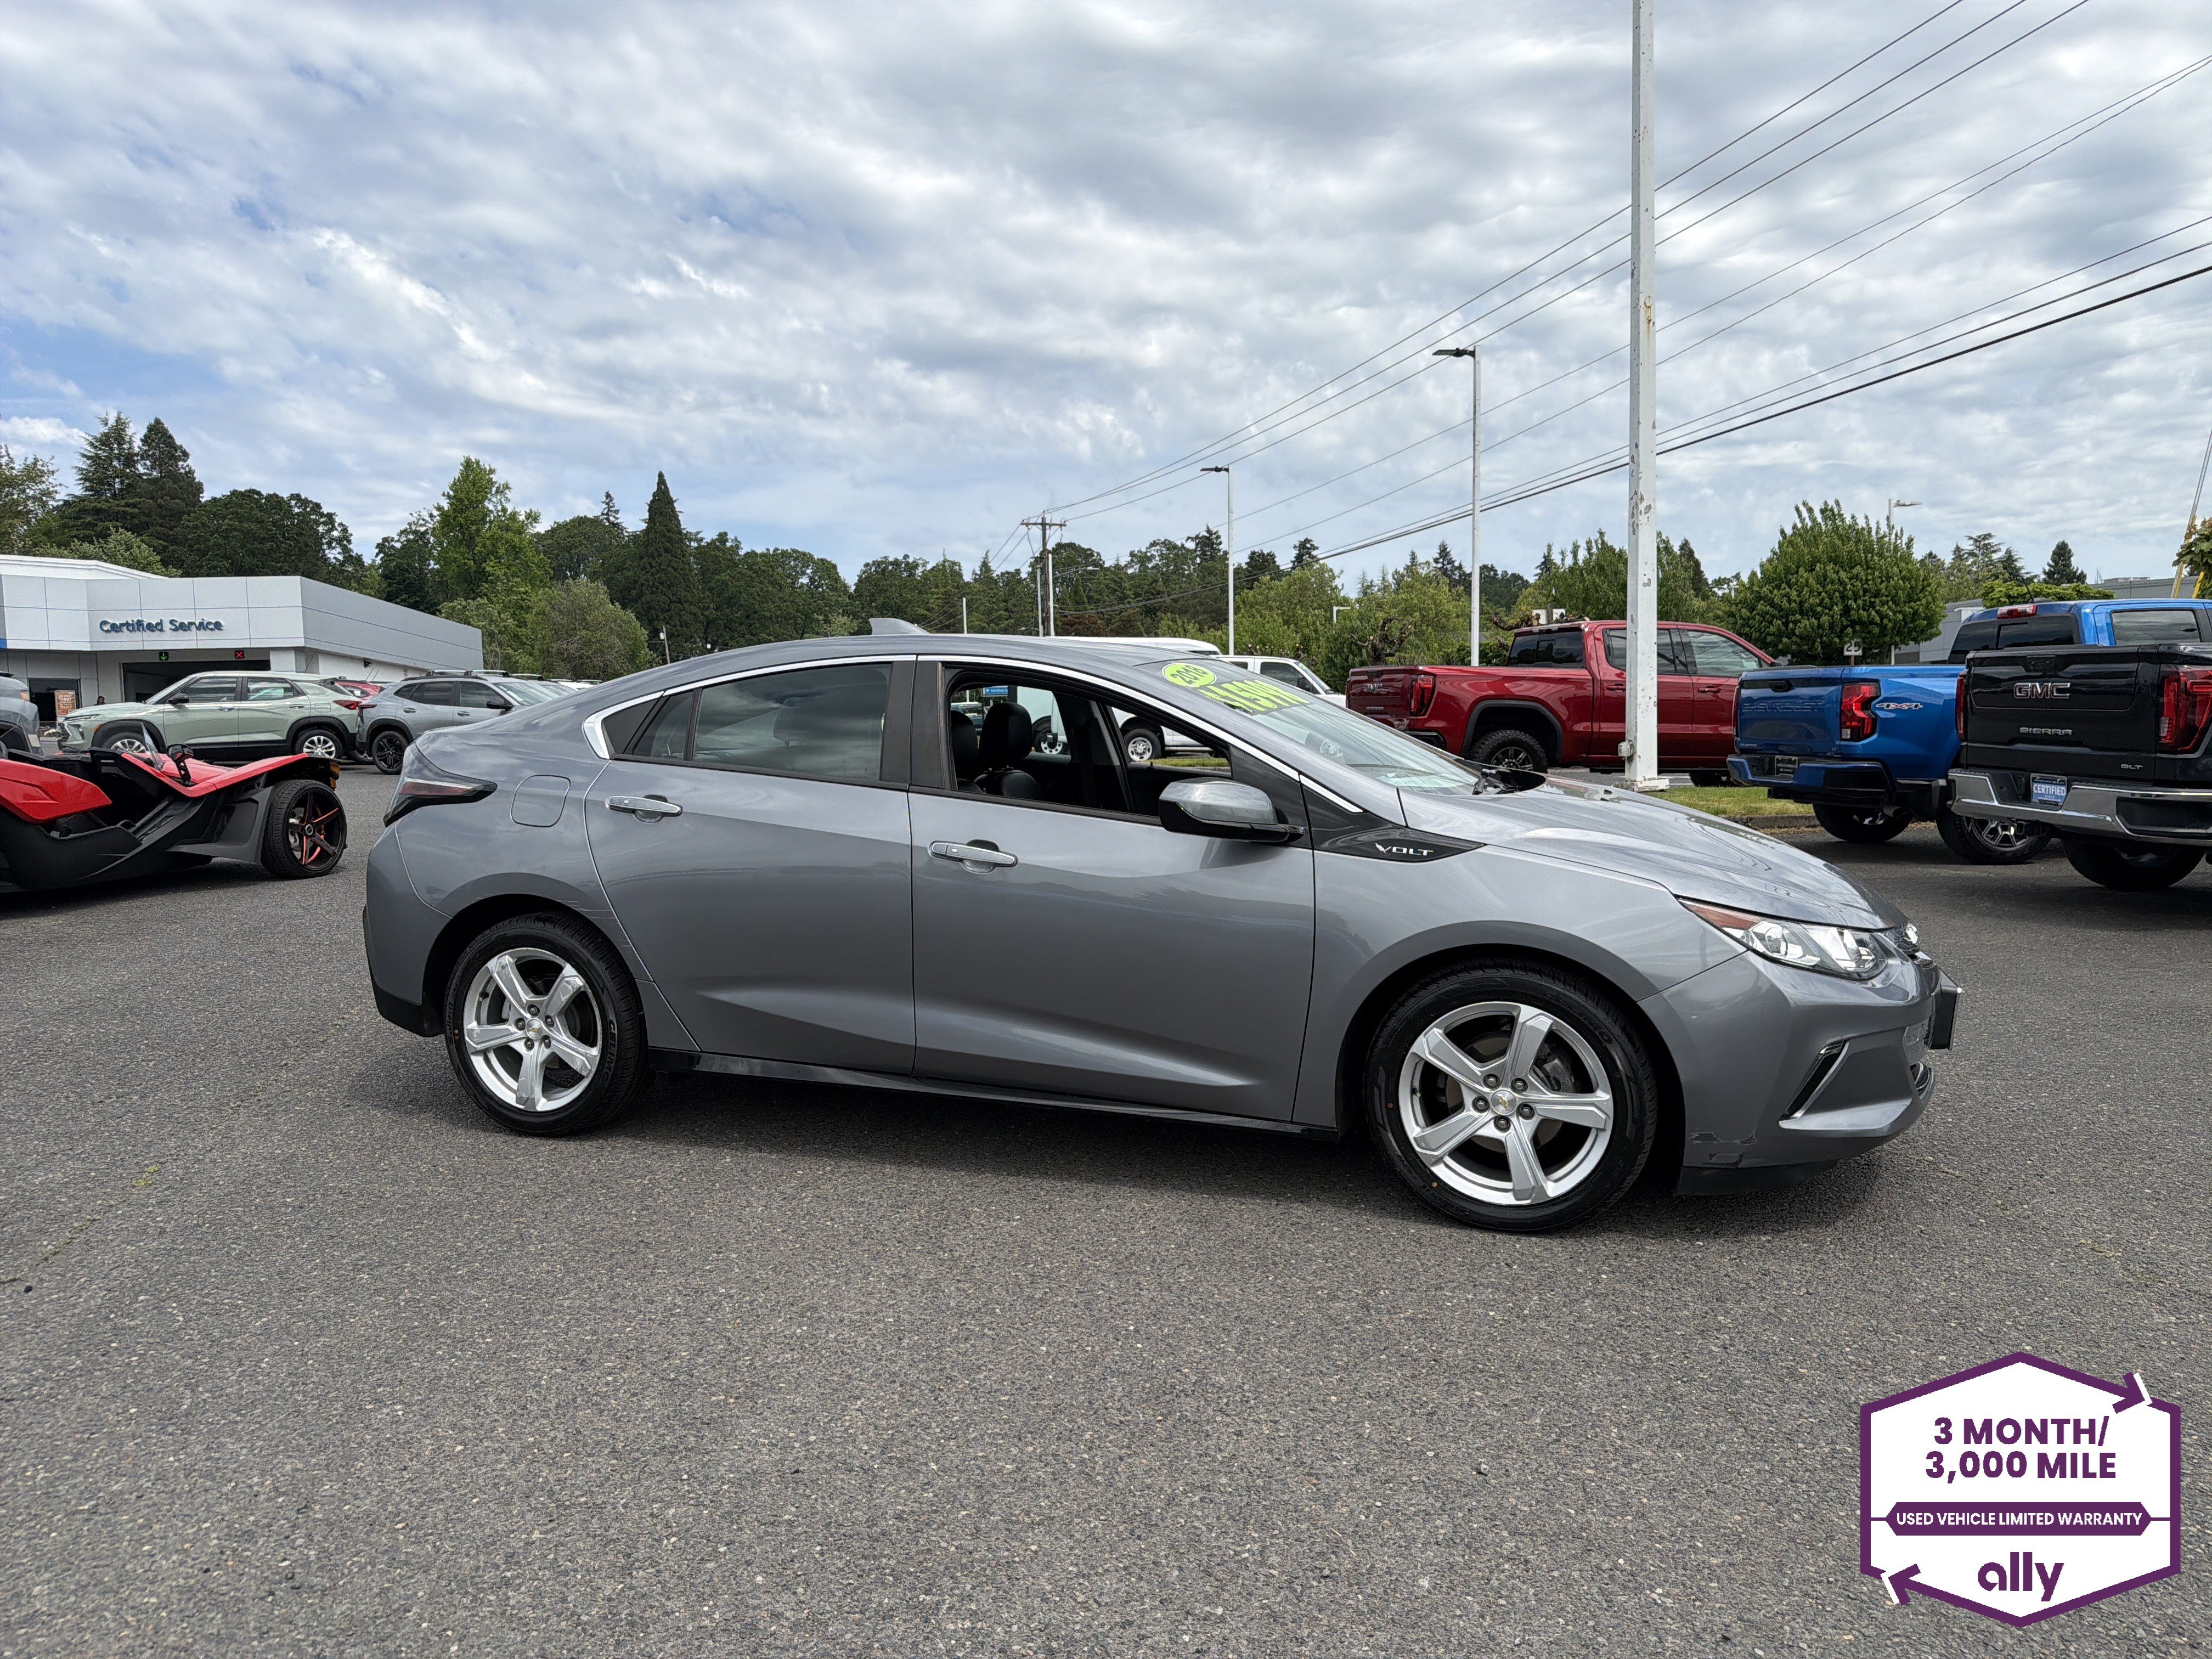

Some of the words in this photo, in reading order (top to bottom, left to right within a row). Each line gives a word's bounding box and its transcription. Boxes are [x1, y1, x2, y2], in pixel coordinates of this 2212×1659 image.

[99, 618, 165, 633] Certified
[169, 618, 223, 631] Service
[1170, 665, 1209, 685] 2018
[2013, 682, 2070, 699] GMC
[2033, 784, 2066, 796] CERTIFIED
[1375, 843, 1434, 856] VOLT
